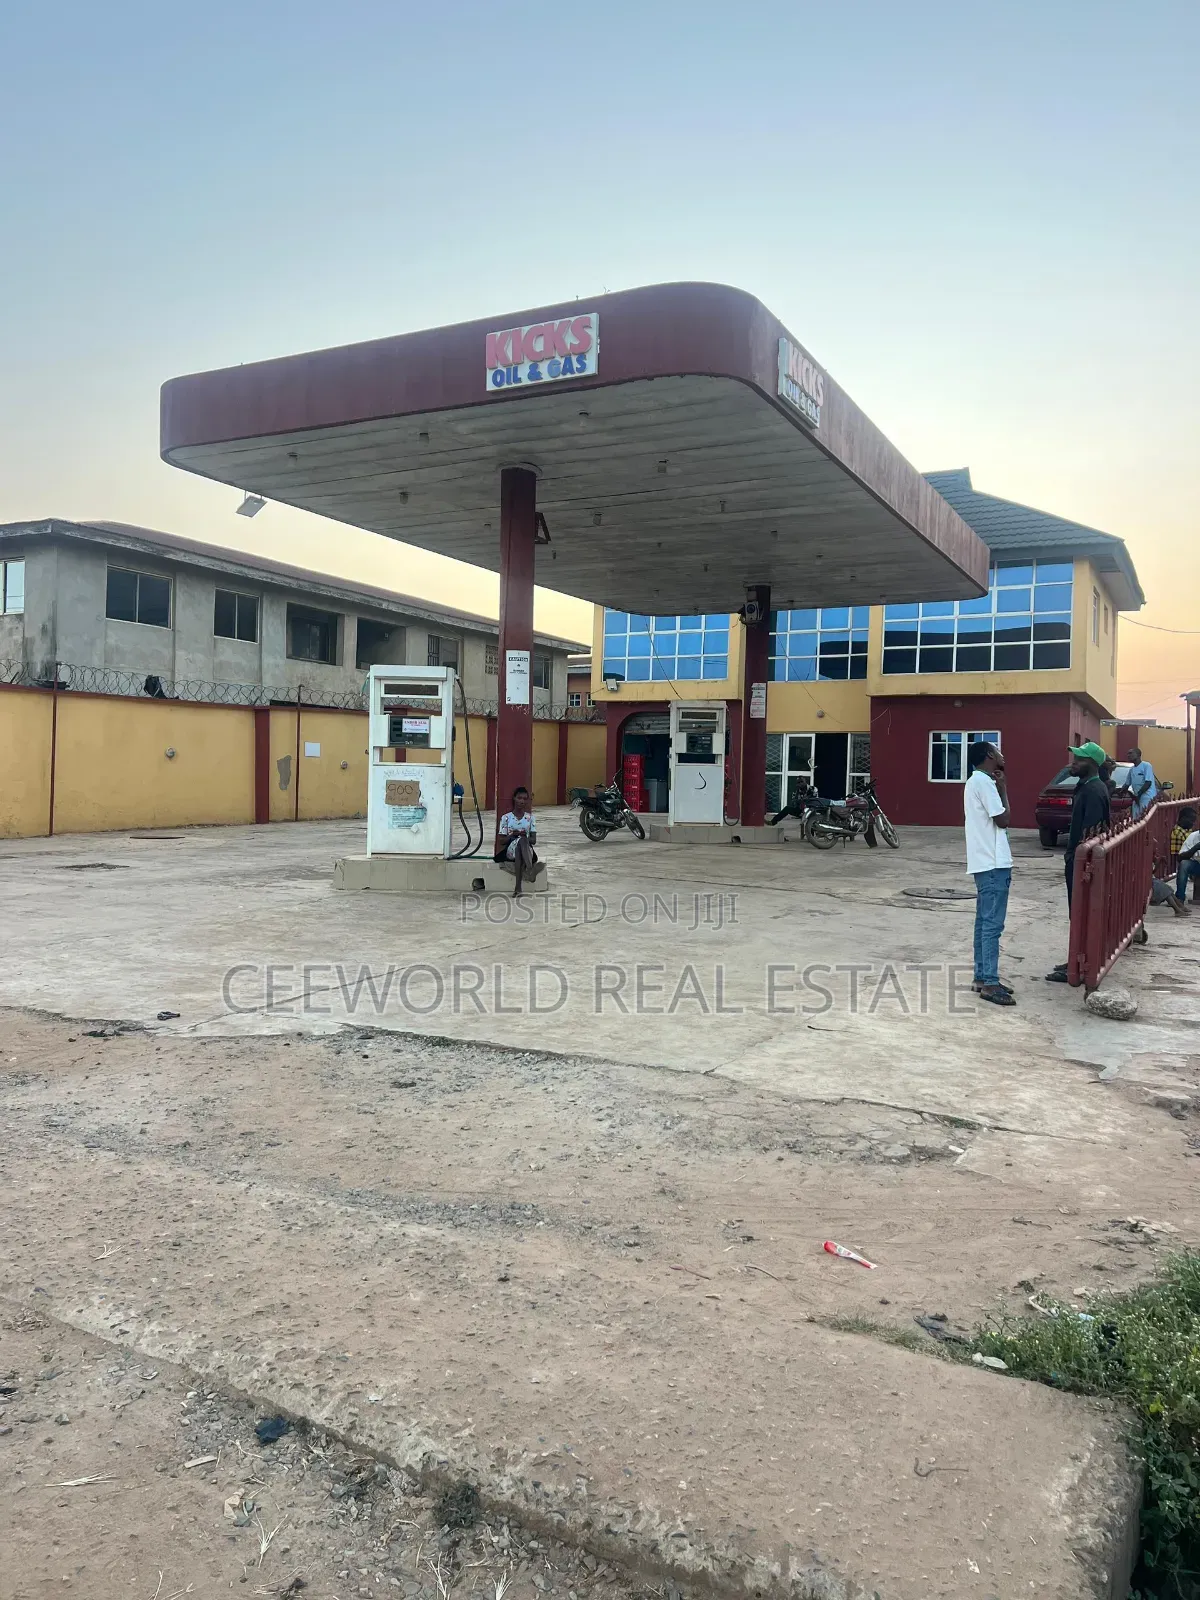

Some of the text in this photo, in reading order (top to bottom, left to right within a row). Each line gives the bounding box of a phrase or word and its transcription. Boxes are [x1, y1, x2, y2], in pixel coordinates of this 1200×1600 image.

[486, 316, 592, 370] KICKS
[492, 354, 587, 388] OIL & GAS
[787, 341, 824, 407] KICKS
[388, 783, 413, 796] 900
